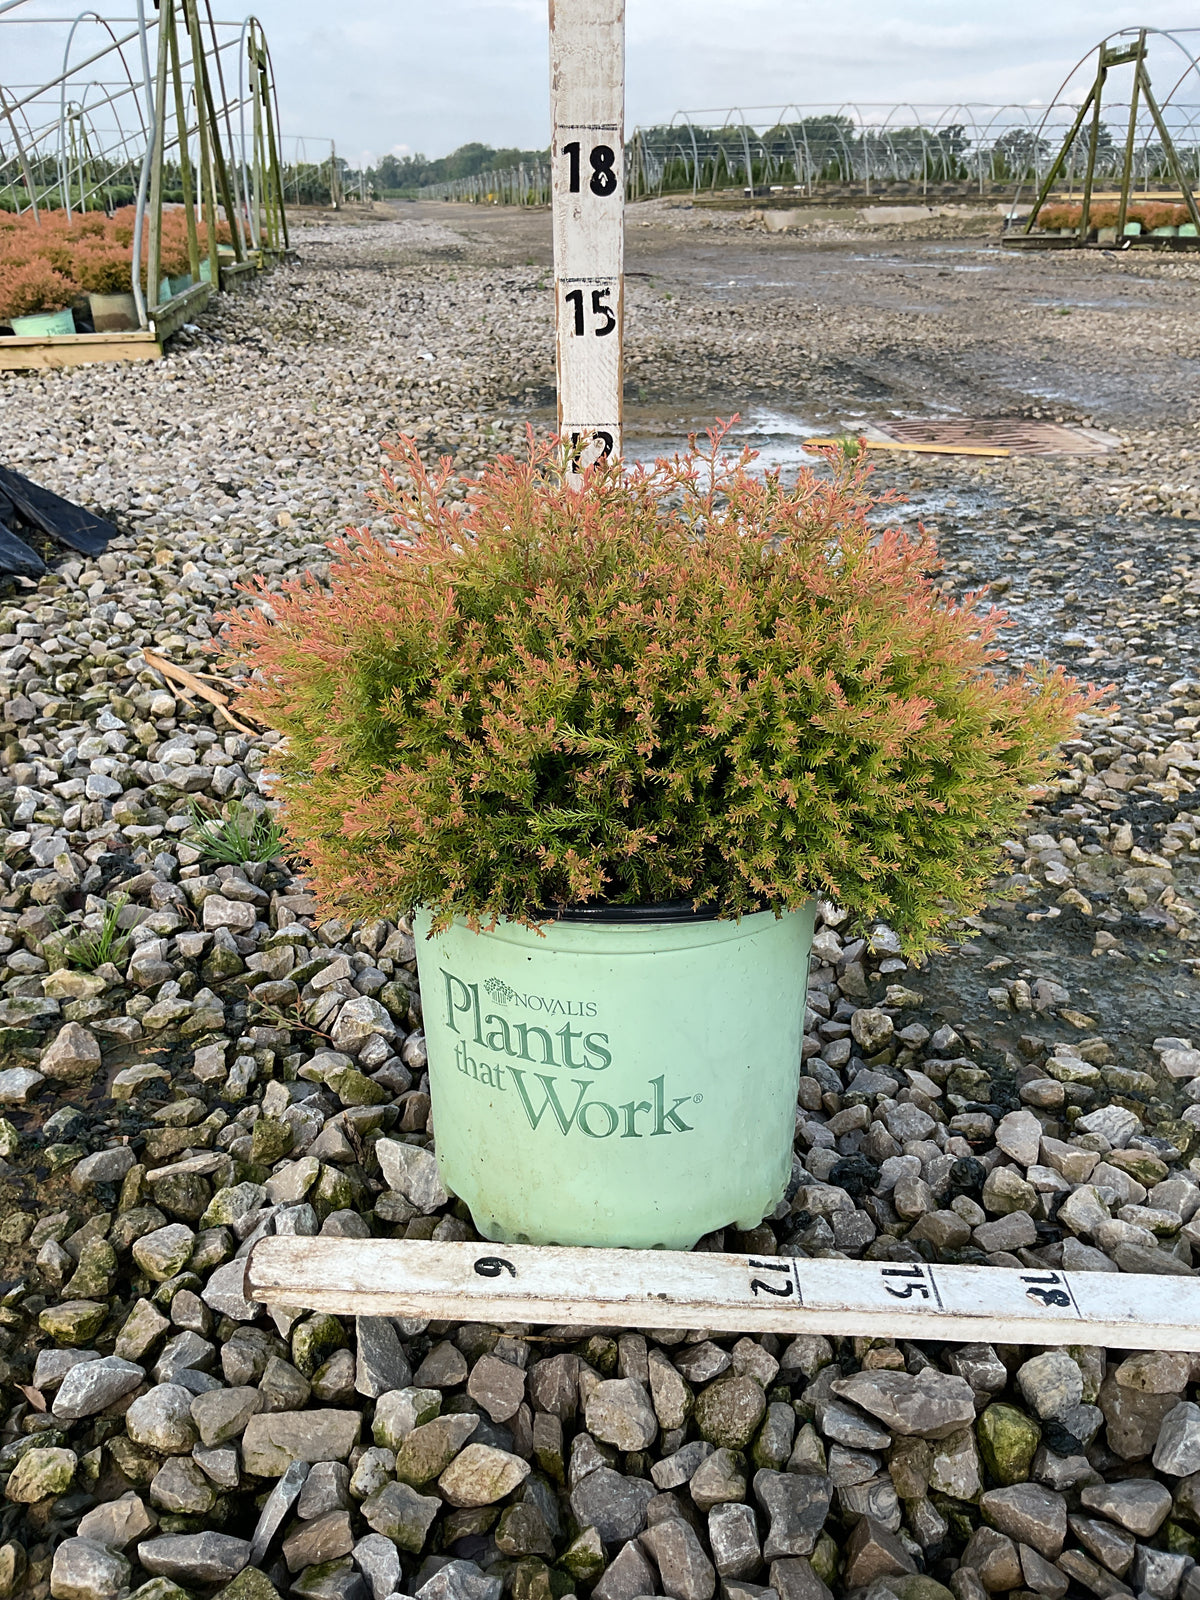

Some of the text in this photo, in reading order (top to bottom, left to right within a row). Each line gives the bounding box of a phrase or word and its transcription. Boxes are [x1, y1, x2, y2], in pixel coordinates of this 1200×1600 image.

[562, 142, 618, 197] 18
[565, 286, 617, 337] 15
[439, 967, 612, 1071] Plants
[515, 992, 598, 1017] NOVALIS
[454, 1040, 507, 1091] that
[749, 1259, 794, 1297] 12
[881, 1264, 930, 1299] 15
[1019, 1271, 1071, 1307] 18
